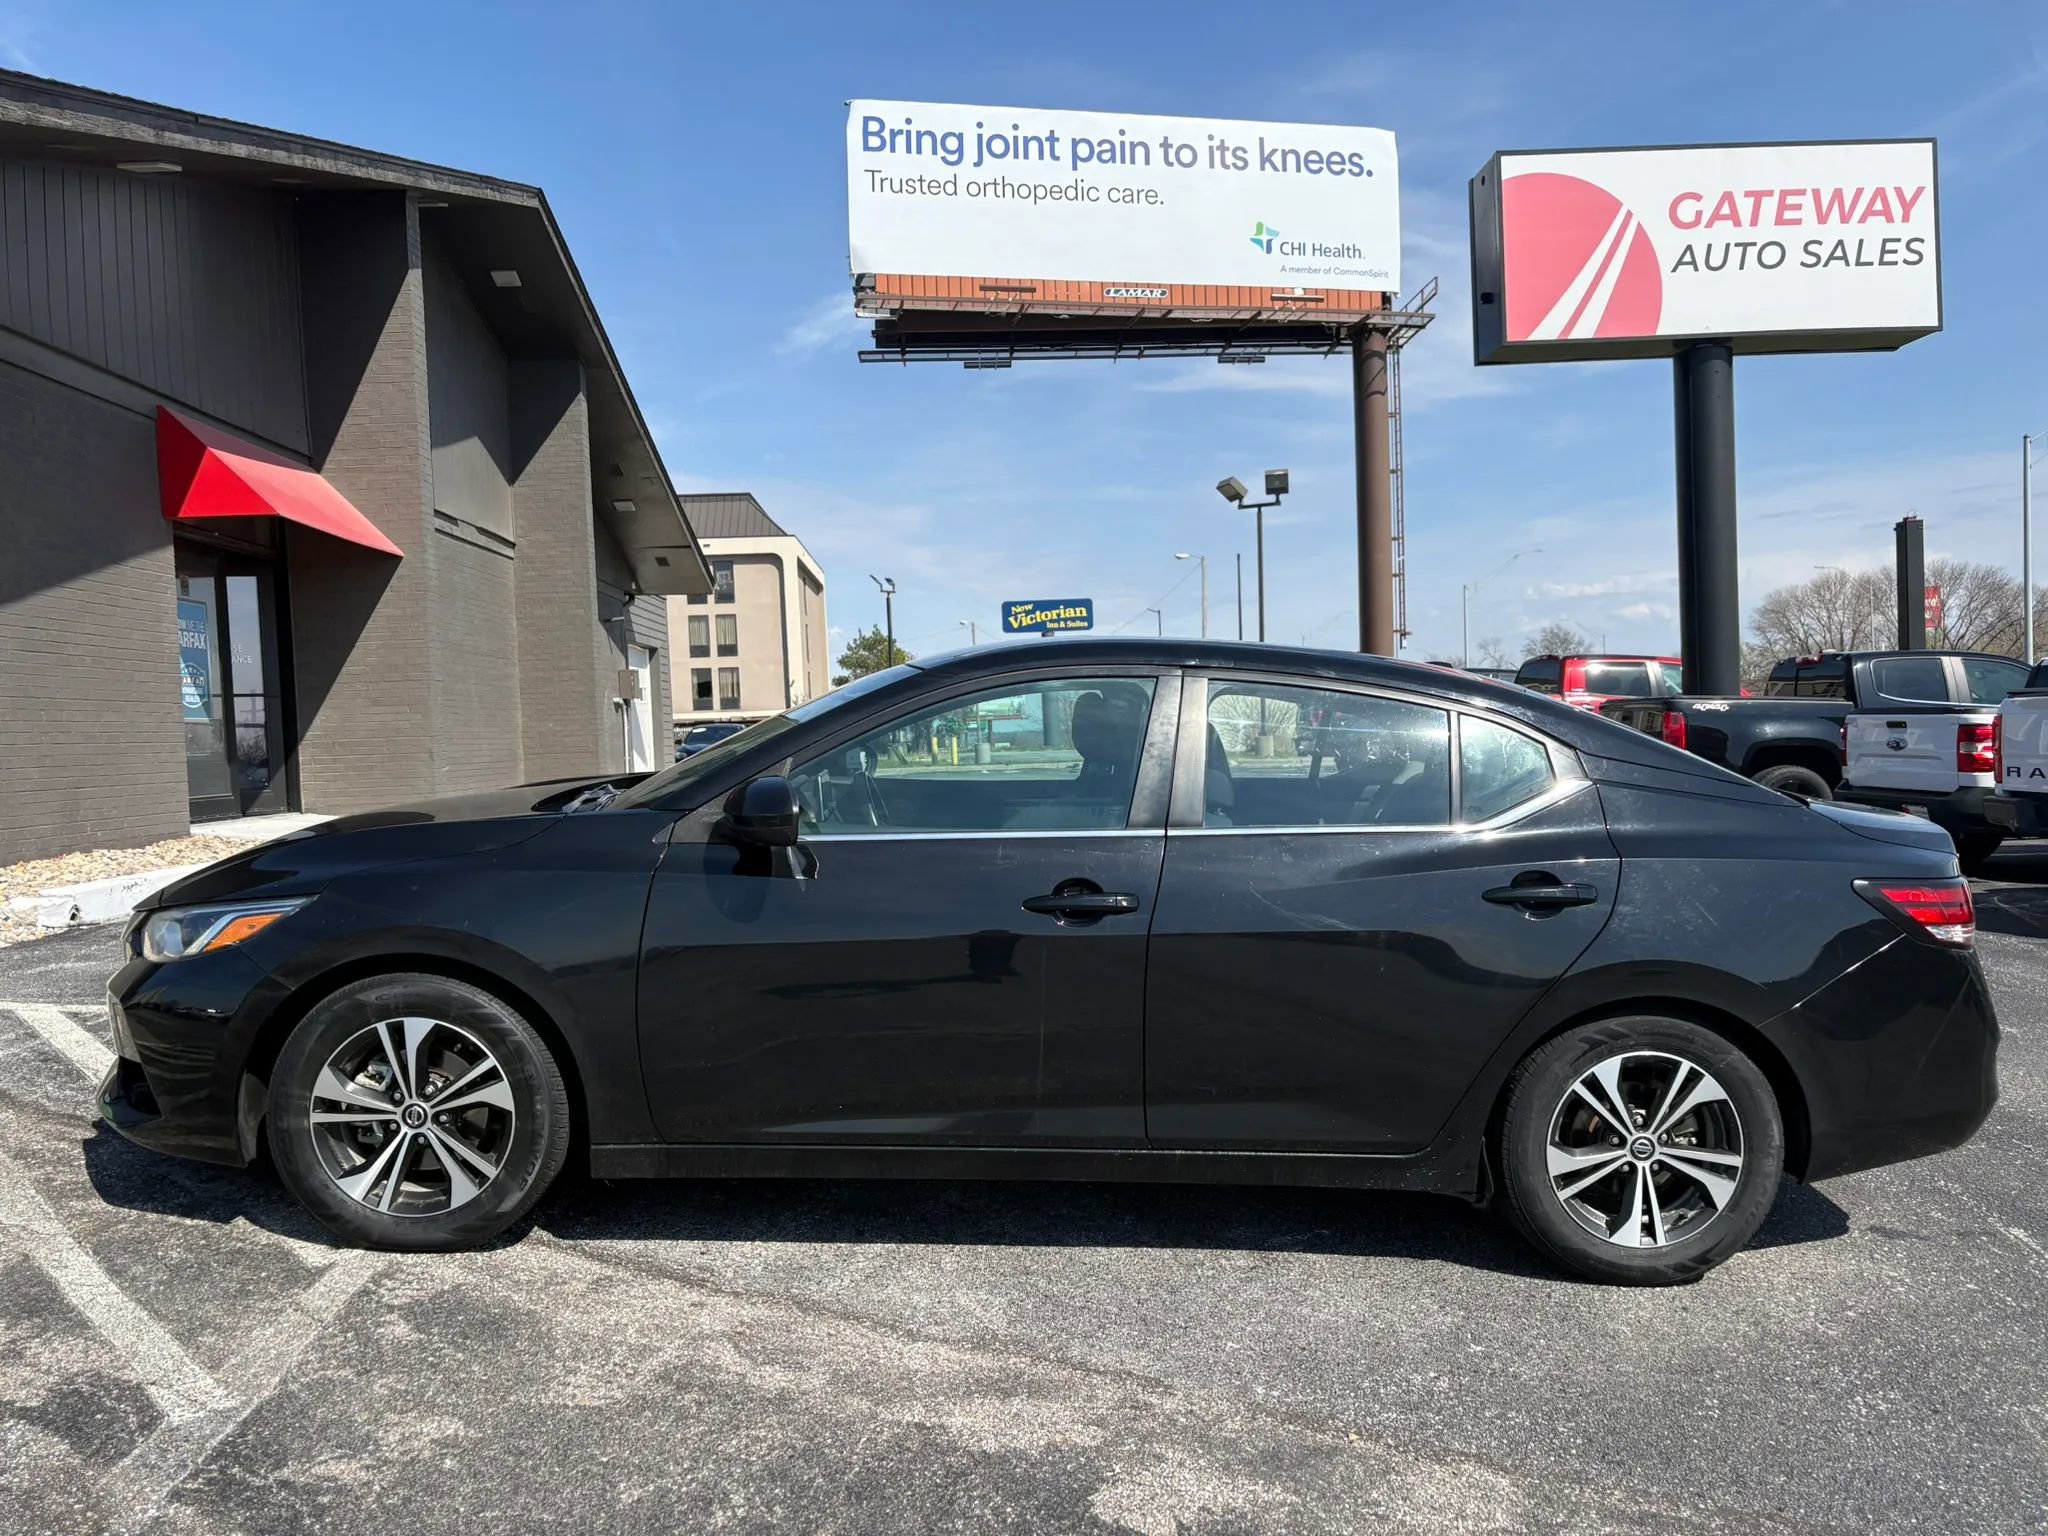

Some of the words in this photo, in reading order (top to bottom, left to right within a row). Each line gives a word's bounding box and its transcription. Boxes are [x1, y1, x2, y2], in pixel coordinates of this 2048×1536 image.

[862, 115, 965, 167] Bring
[973, 121, 1061, 168] joint
[1071, 128, 1151, 172] pain
[1159, 135, 1199, 169] to
[1207, 133, 1250, 172] its
[1258, 136, 1374, 178] knees.
[863, 168, 959, 197] Trusted
[966, 175, 1101, 206] orthopedic
[1107, 186, 1164, 206] care.
[1668, 185, 1927, 230] GATEWAY
[1279, 241, 1307, 257] CHI
[1670, 240, 1787, 273] AUTO
[1799, 236, 1926, 269] SALES
[1280, 264, 1288, 274] A
[1289, 265, 1321, 275] member
[1323, 266, 1332, 275] of
[1333, 267, 1390, 279] CommonSpirit
[1109, 287, 1162, 298] LAMAR
[1007, 605, 1088, 630] Victorian
[1011, 603, 1034, 614] New
[1046, 621, 1059, 629] Inn
[1059, 620, 1066, 628] &
[1066, 619, 1089, 628] Suites
